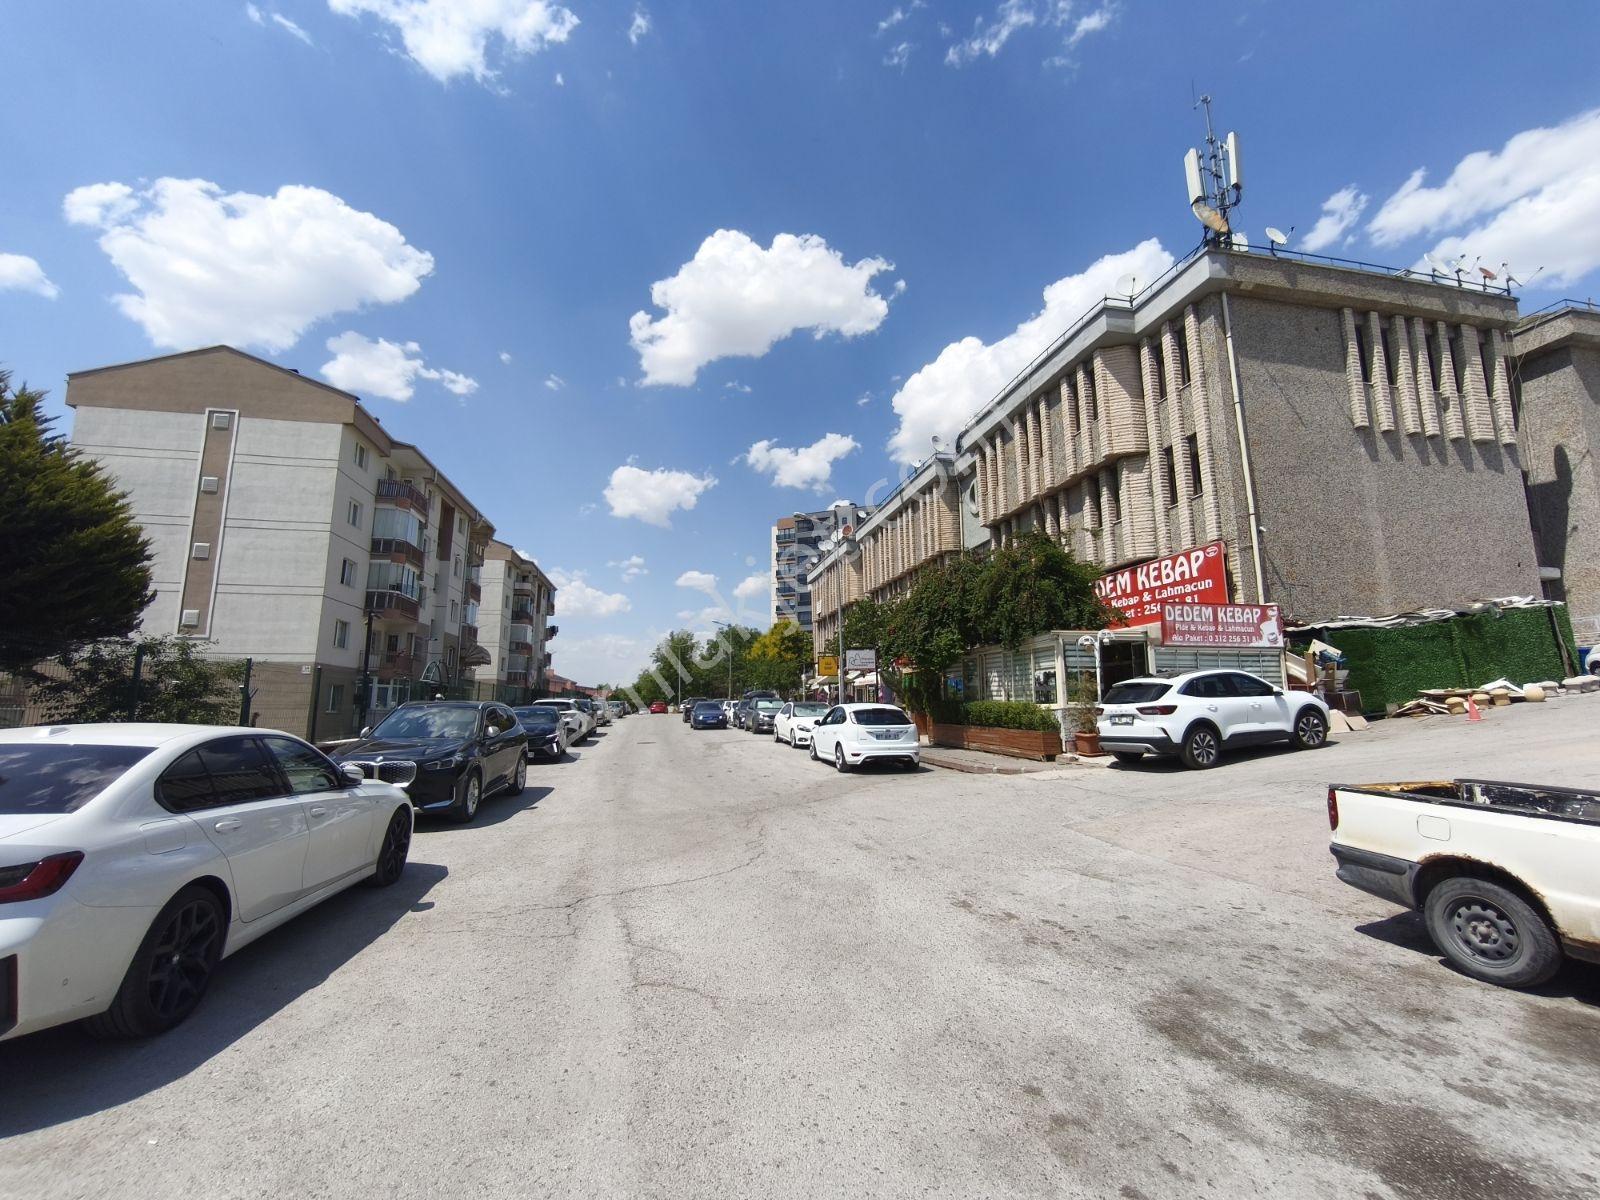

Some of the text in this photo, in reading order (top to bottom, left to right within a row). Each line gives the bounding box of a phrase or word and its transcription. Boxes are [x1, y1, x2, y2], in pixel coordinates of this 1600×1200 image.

[1137, 550, 1204, 590] KEBAP
[1111, 579, 1212, 608] Kebap & Lahmacun
[1165, 605, 1261, 623] DEDEM KEBAP
